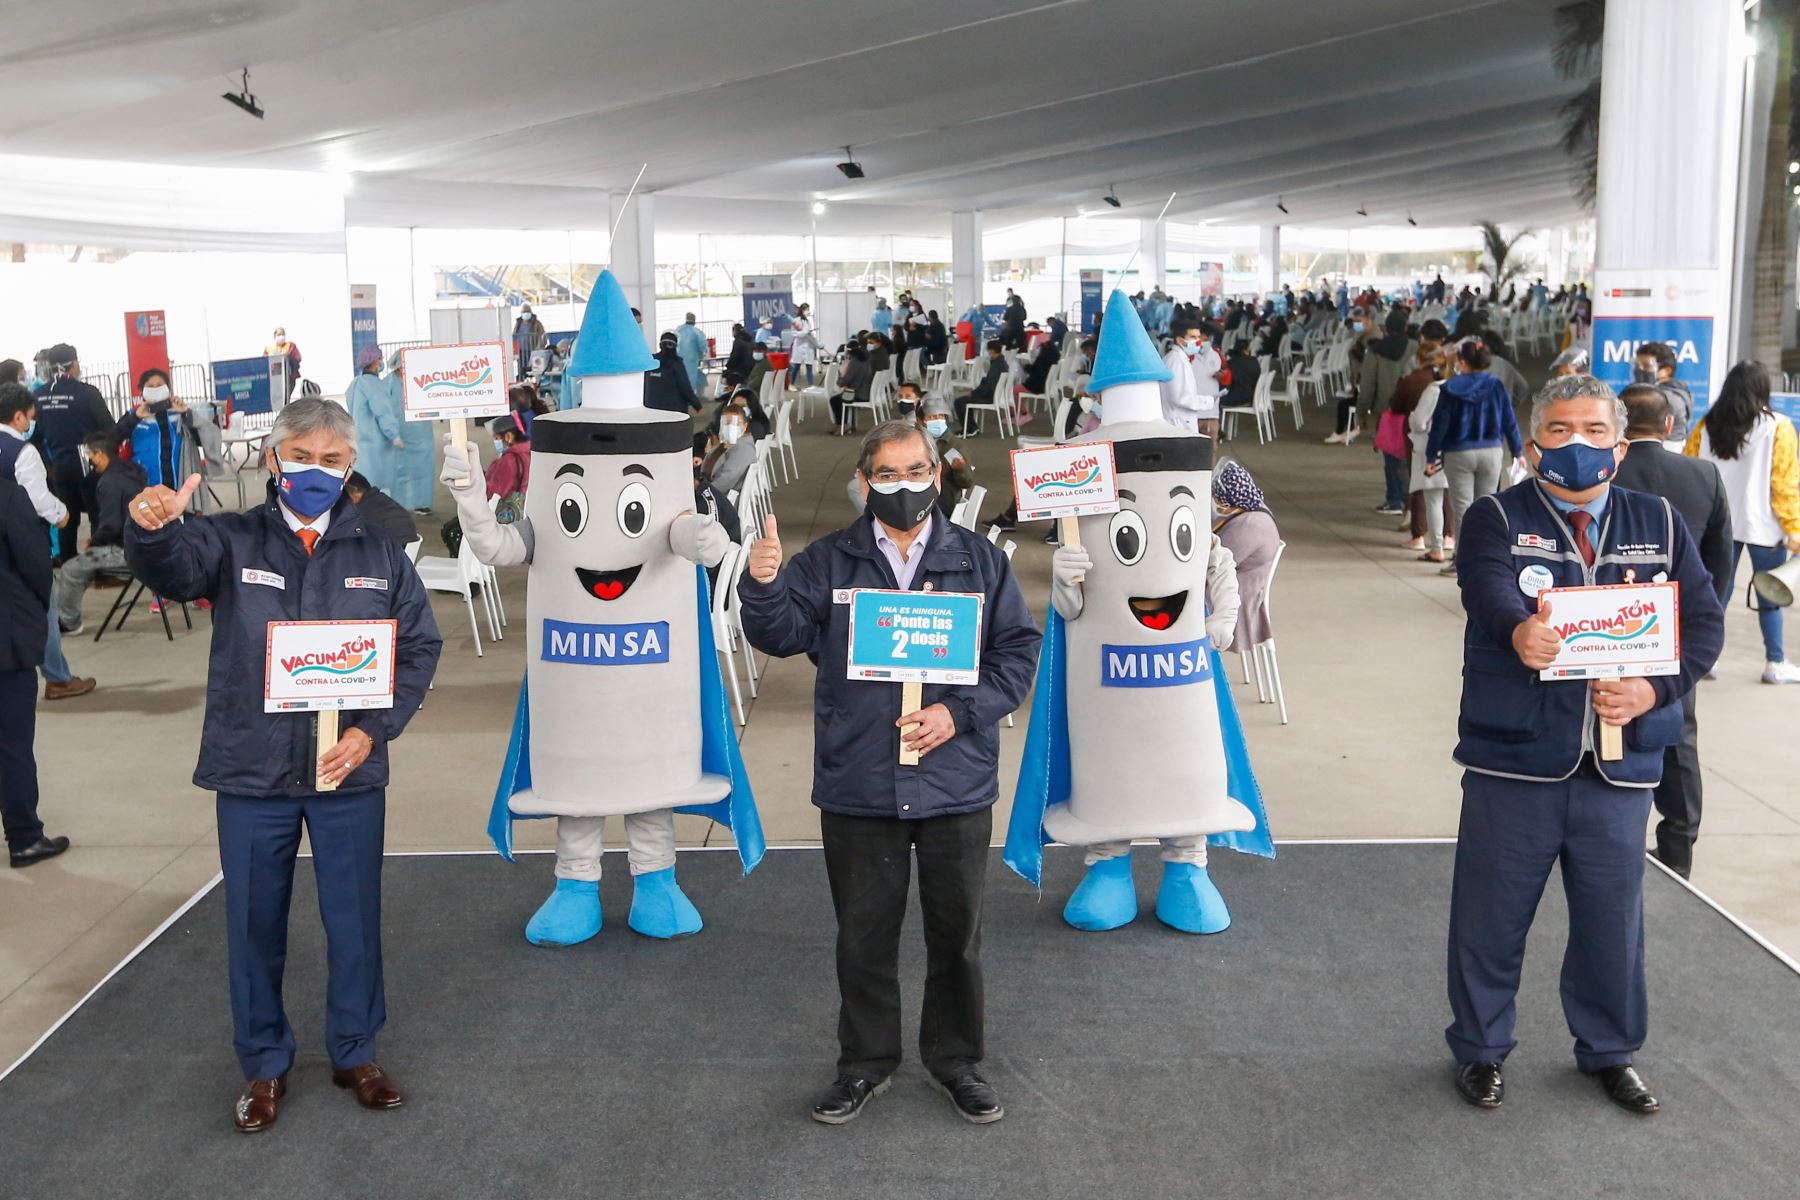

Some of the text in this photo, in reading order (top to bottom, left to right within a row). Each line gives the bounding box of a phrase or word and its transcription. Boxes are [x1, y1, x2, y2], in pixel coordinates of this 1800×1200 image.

[752, 299, 785, 319] MINSA
[413, 355, 490, 388] VACUNATÓN
[1024, 455, 1098, 489] VACUNATÓN
[1074, 487, 1103, 495] COVID-19
[912, 607, 954, 616] NINGUNA.
[933, 616, 953, 630] las
[1553, 600, 1656, 640] VACUNATÓN
[280, 635, 376, 672] VACUNATÓN
[551, 629, 662, 657] MINSA
[891, 629, 949, 659] 2 dosis
[1571, 644, 1606, 652] CONTRA
[1620, 642, 1659, 650] COVID-19
[1109, 646, 1209, 678] MINSA
[341, 676, 376, 684] COVID-19
